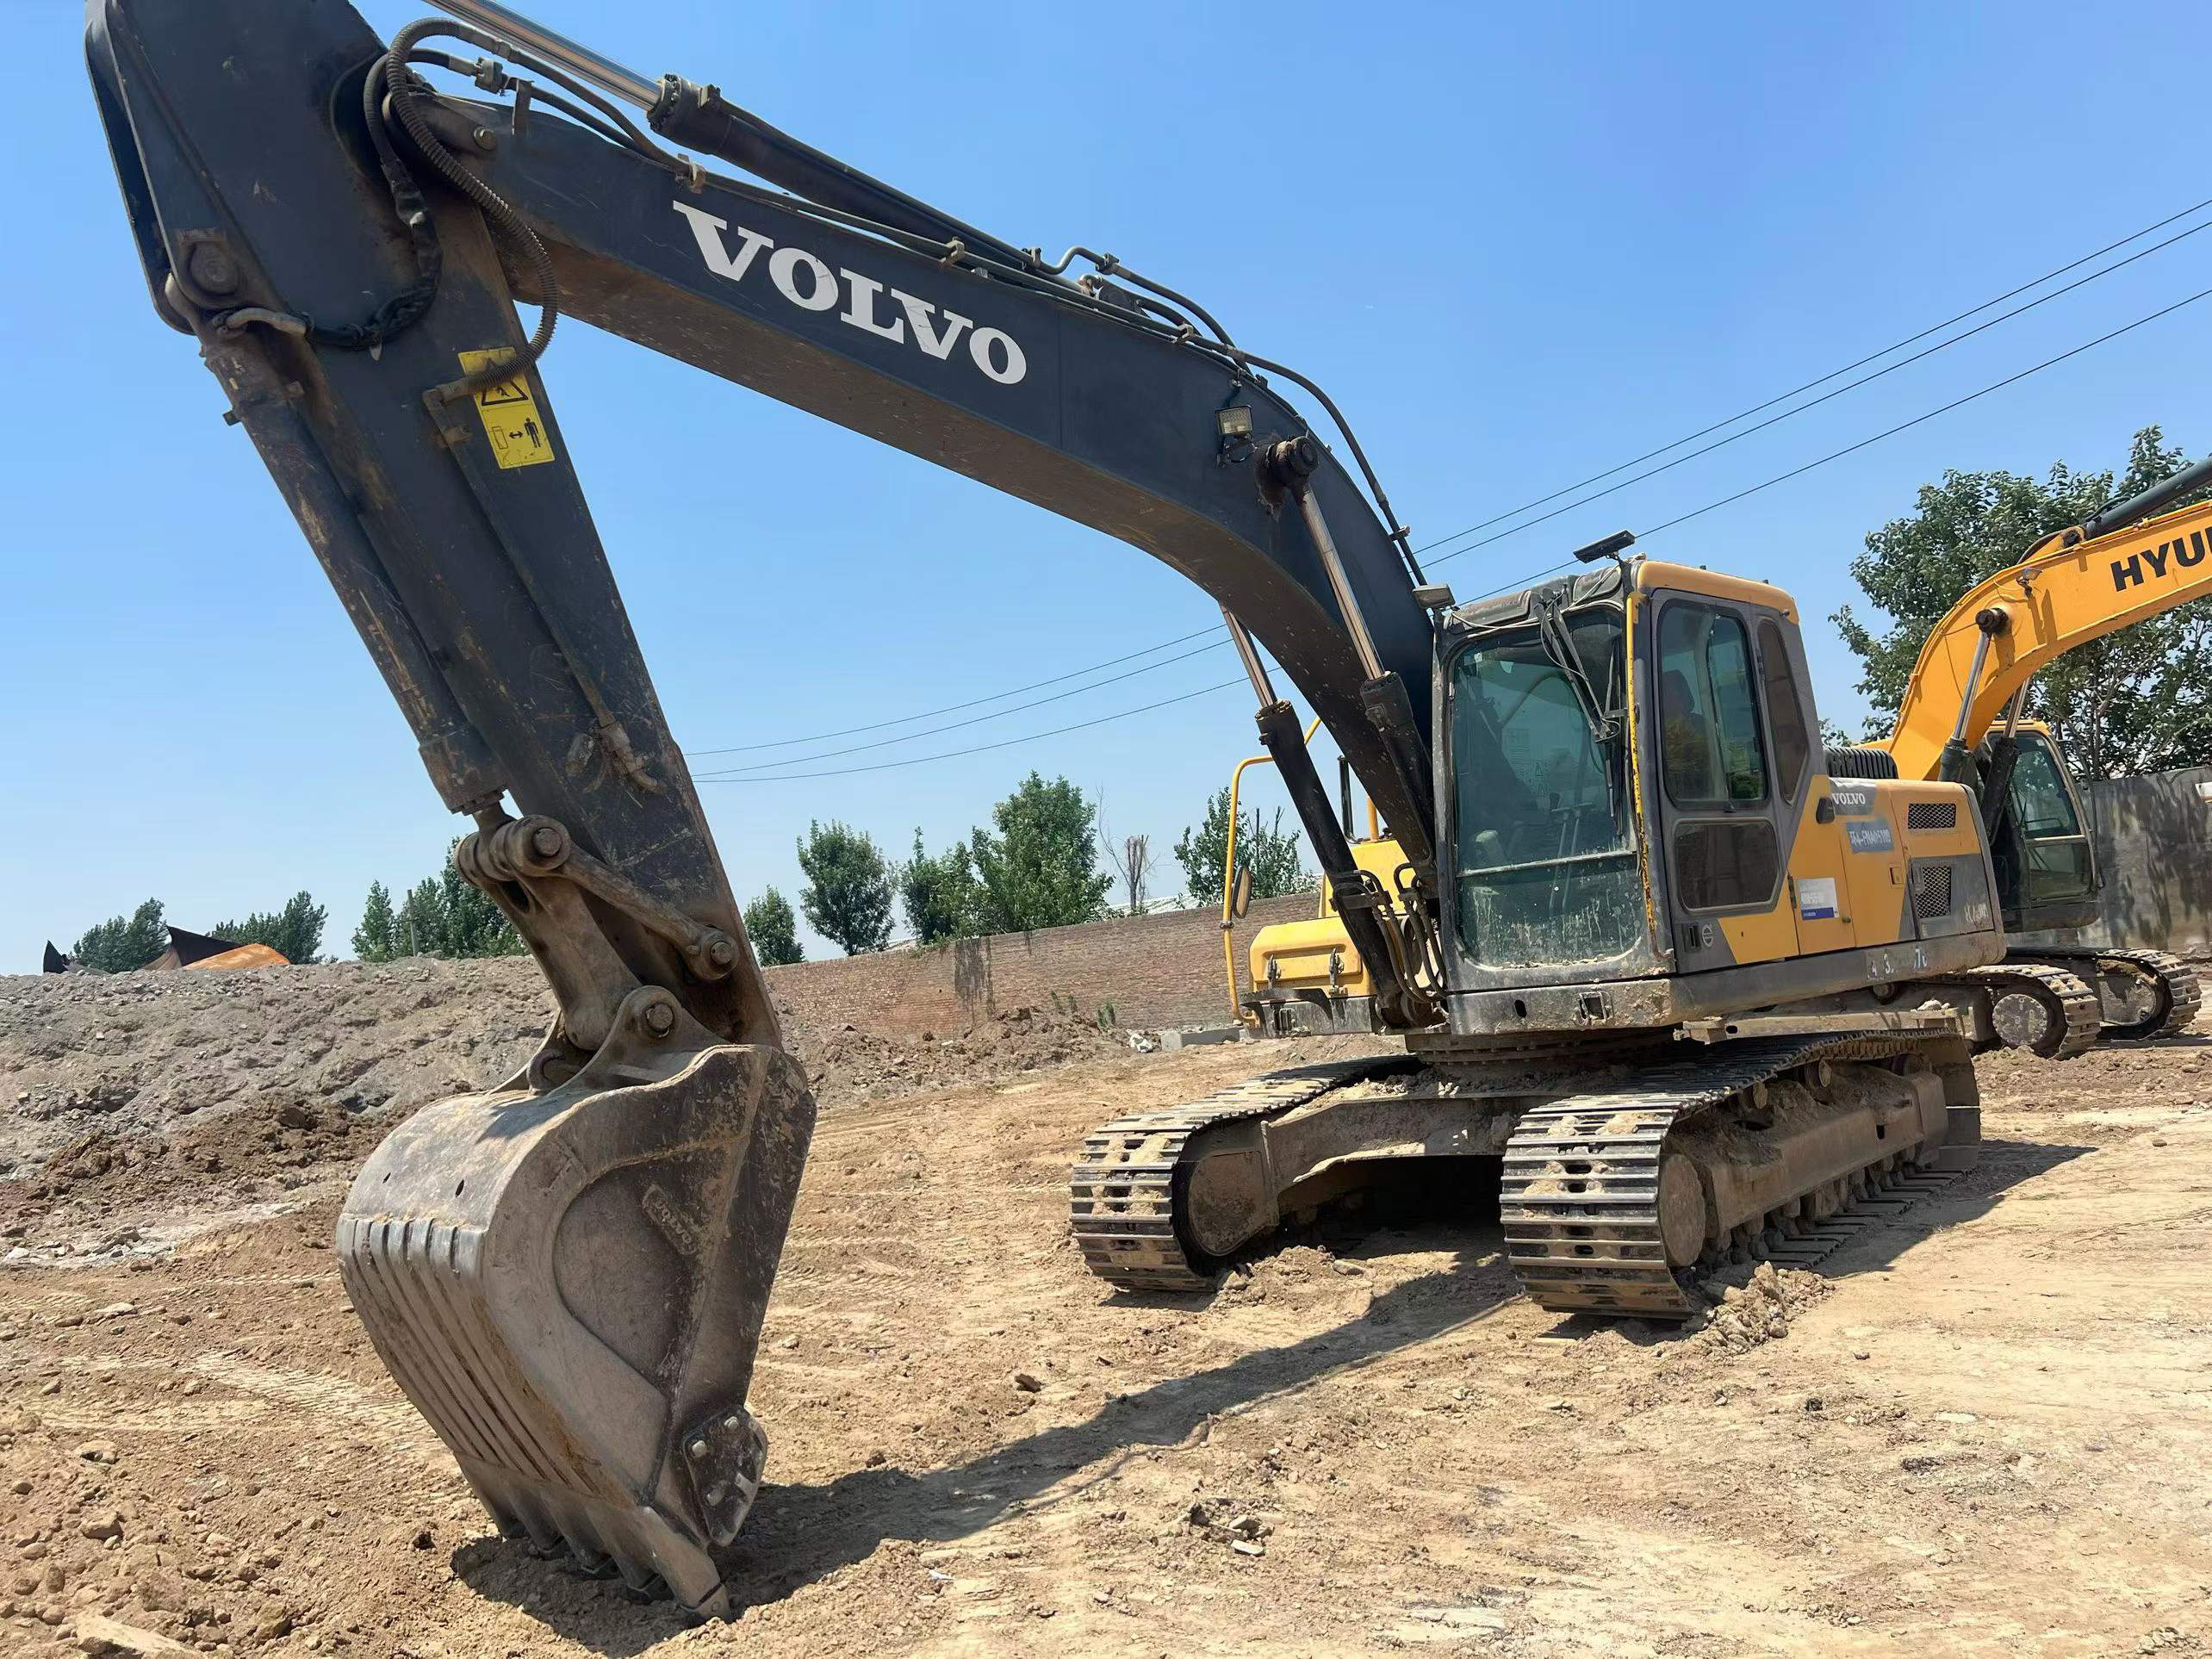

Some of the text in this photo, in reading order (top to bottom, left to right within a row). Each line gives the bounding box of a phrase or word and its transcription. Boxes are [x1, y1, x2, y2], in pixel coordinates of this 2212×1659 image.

[673, 200, 1027, 385] VOLVO
[2110, 526, 2212, 592] HYU
[1831, 792, 1866, 805] VOLVO
